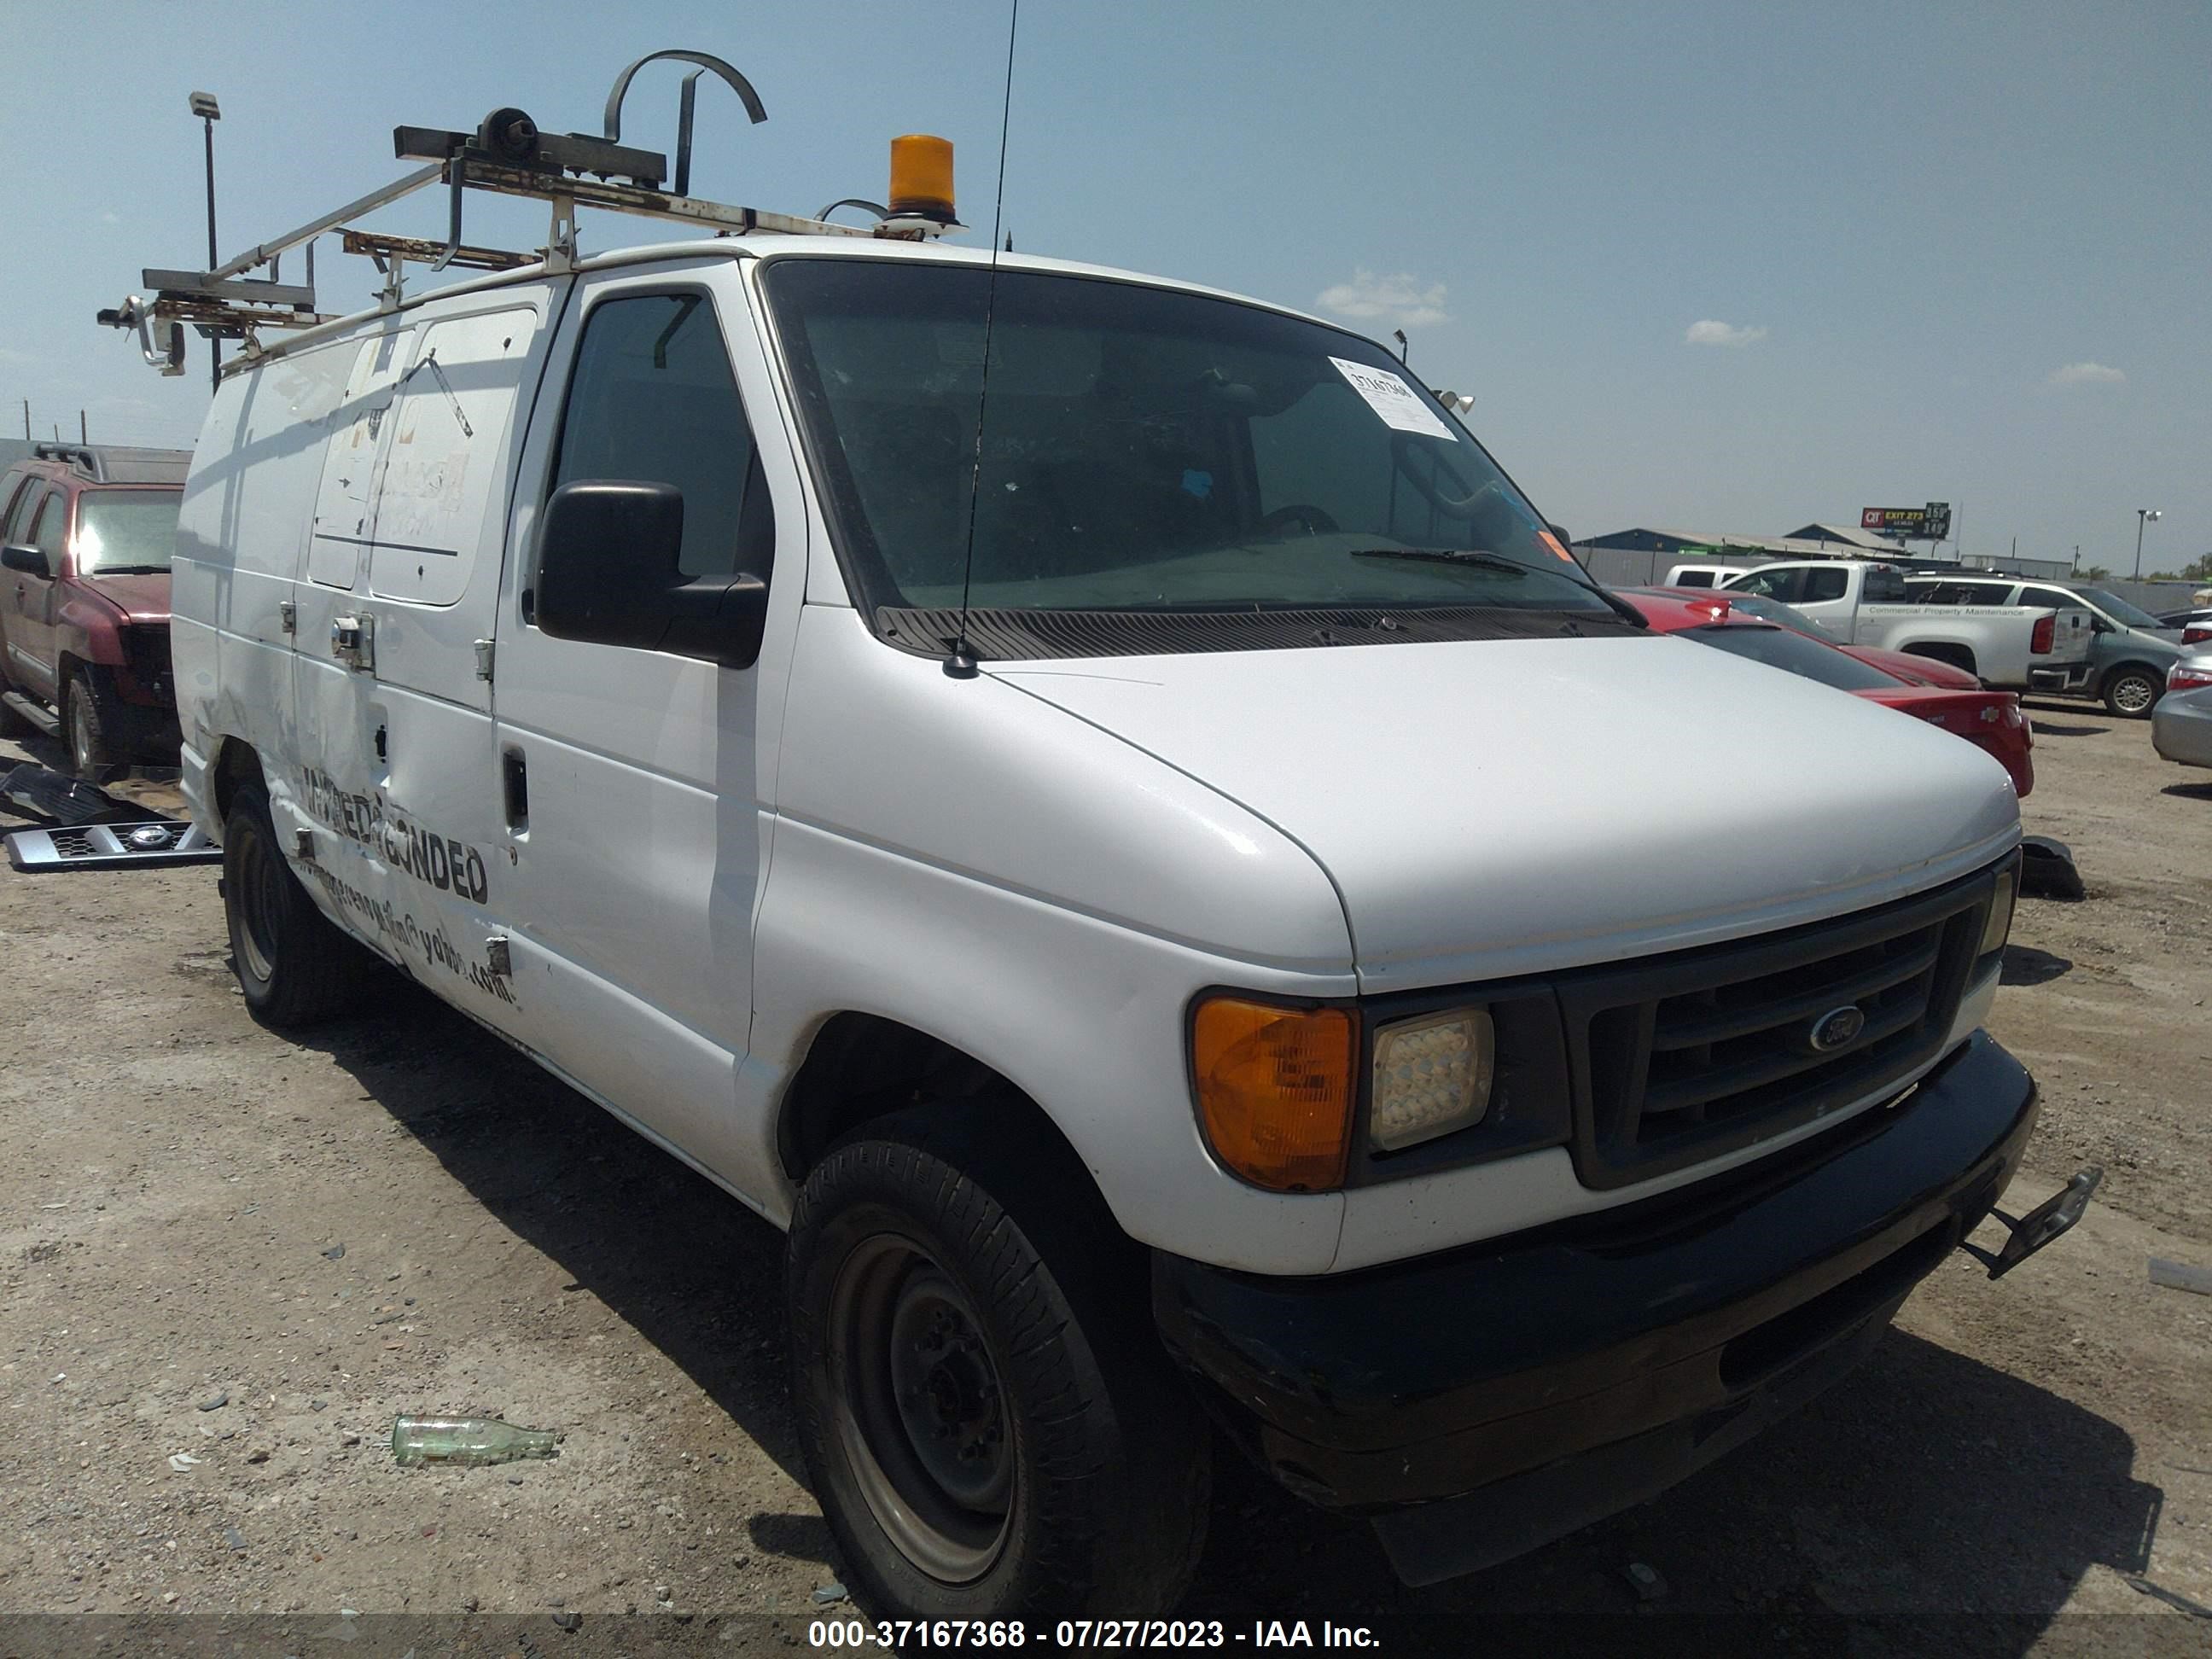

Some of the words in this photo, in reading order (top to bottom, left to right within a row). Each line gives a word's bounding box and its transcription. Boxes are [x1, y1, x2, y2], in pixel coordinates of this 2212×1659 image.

[1351, 373, 1412, 399] 37167368
[1865, 511, 1881, 524] QT
[1885, 511, 1905, 520] EXIT
[1906, 512, 1924, 521] 273
[1924, 607, 1962, 616] Property
[1965, 608, 2024, 616] Maintenance
